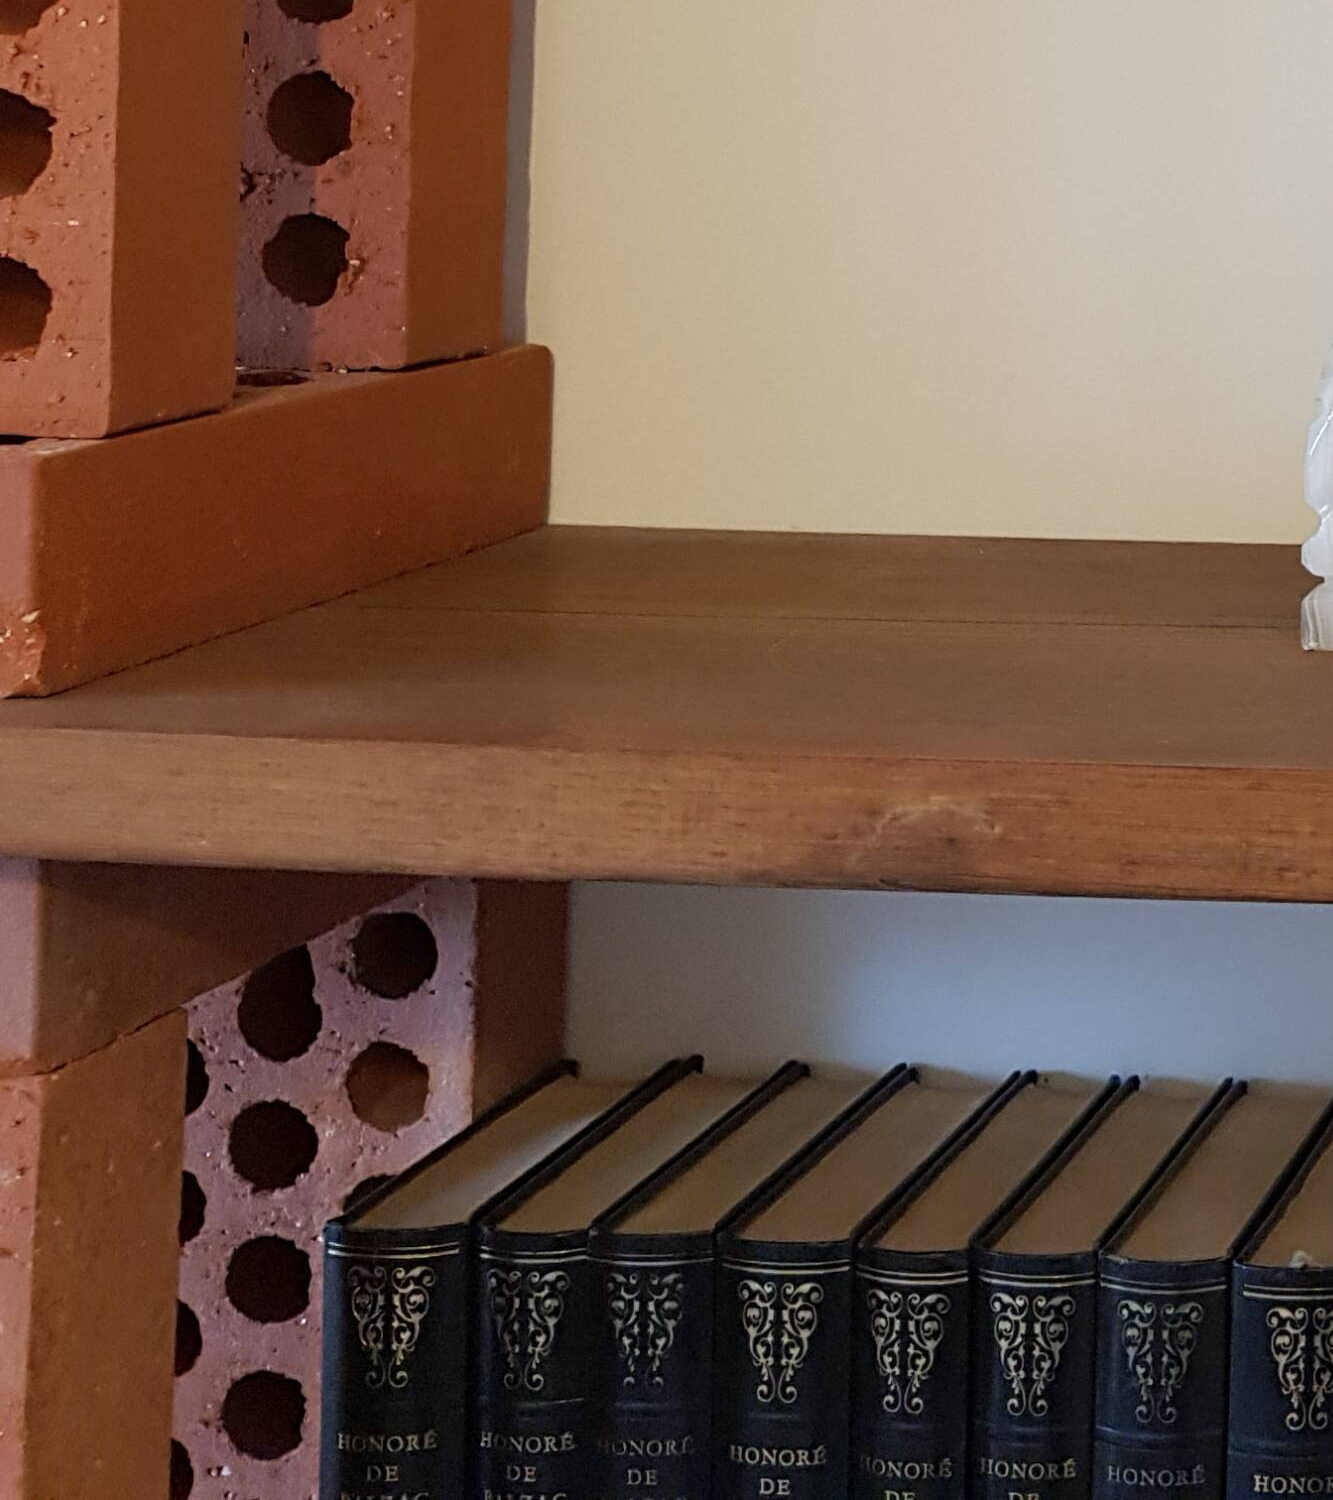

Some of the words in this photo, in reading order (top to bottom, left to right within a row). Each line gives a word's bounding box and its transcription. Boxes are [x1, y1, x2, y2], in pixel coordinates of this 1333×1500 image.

[337, 1430, 438, 1451] HONORÉ
[480, 1431, 575, 1451] HONORÉ
[730, 1444, 827, 1467] HONORÉ
[366, 1466, 399, 1481] DE
[507, 1466, 537, 1482] DE
[626, 1469, 657, 1486] DE
[979, 1457, 1077, 1480] HONORÉ
[1107, 1464, 1206, 1487] HONORÉ
[759, 1478, 791, 1496] DE
